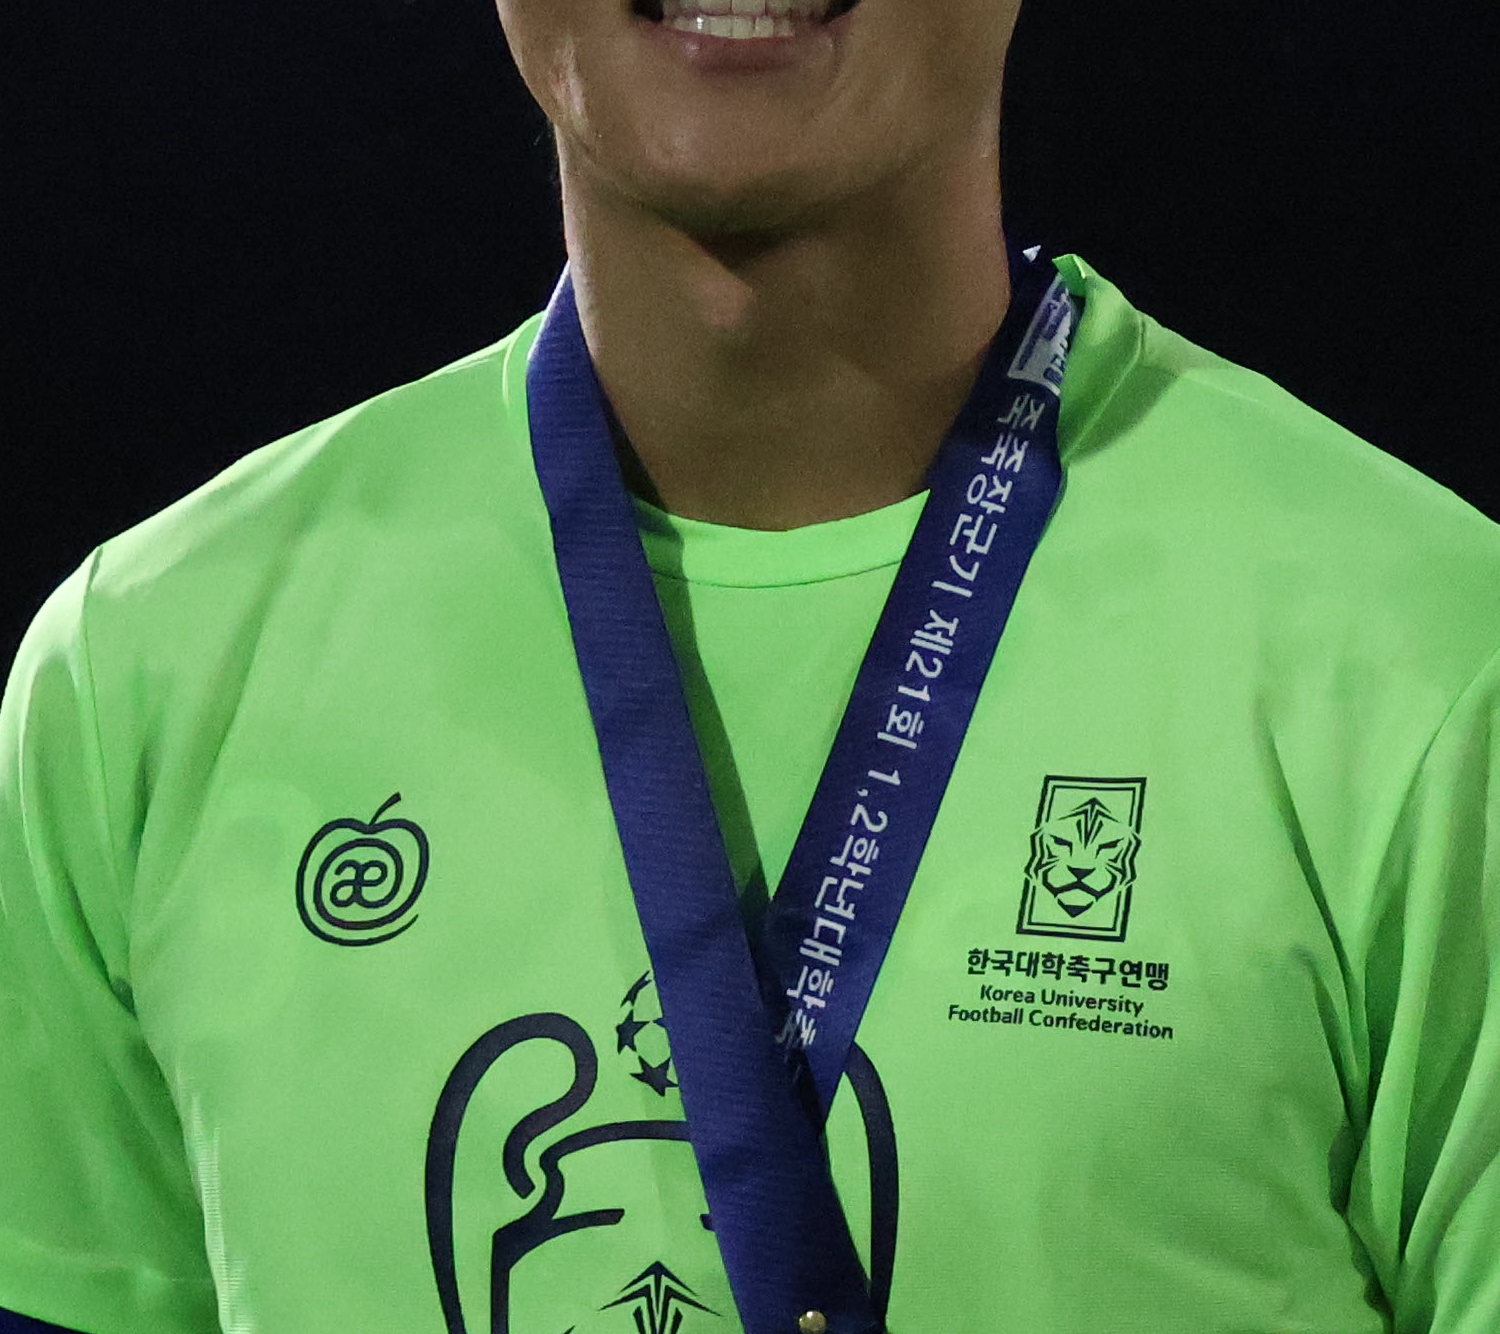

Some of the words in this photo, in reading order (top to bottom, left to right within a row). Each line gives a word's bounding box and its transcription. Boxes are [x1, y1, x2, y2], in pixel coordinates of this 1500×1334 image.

[931, 394, 1047, 598] 죽죽장군기
[877, 609, 960, 750] 제21회
[967, 948, 1170, 992] 한국대학축구연맹
[948, 1004, 1024, 1025] Football
[1029, 1009, 1174, 1040] Confederation
[980, 984, 1036, 1004] Korea
[1041, 989, 1145, 1017] University
